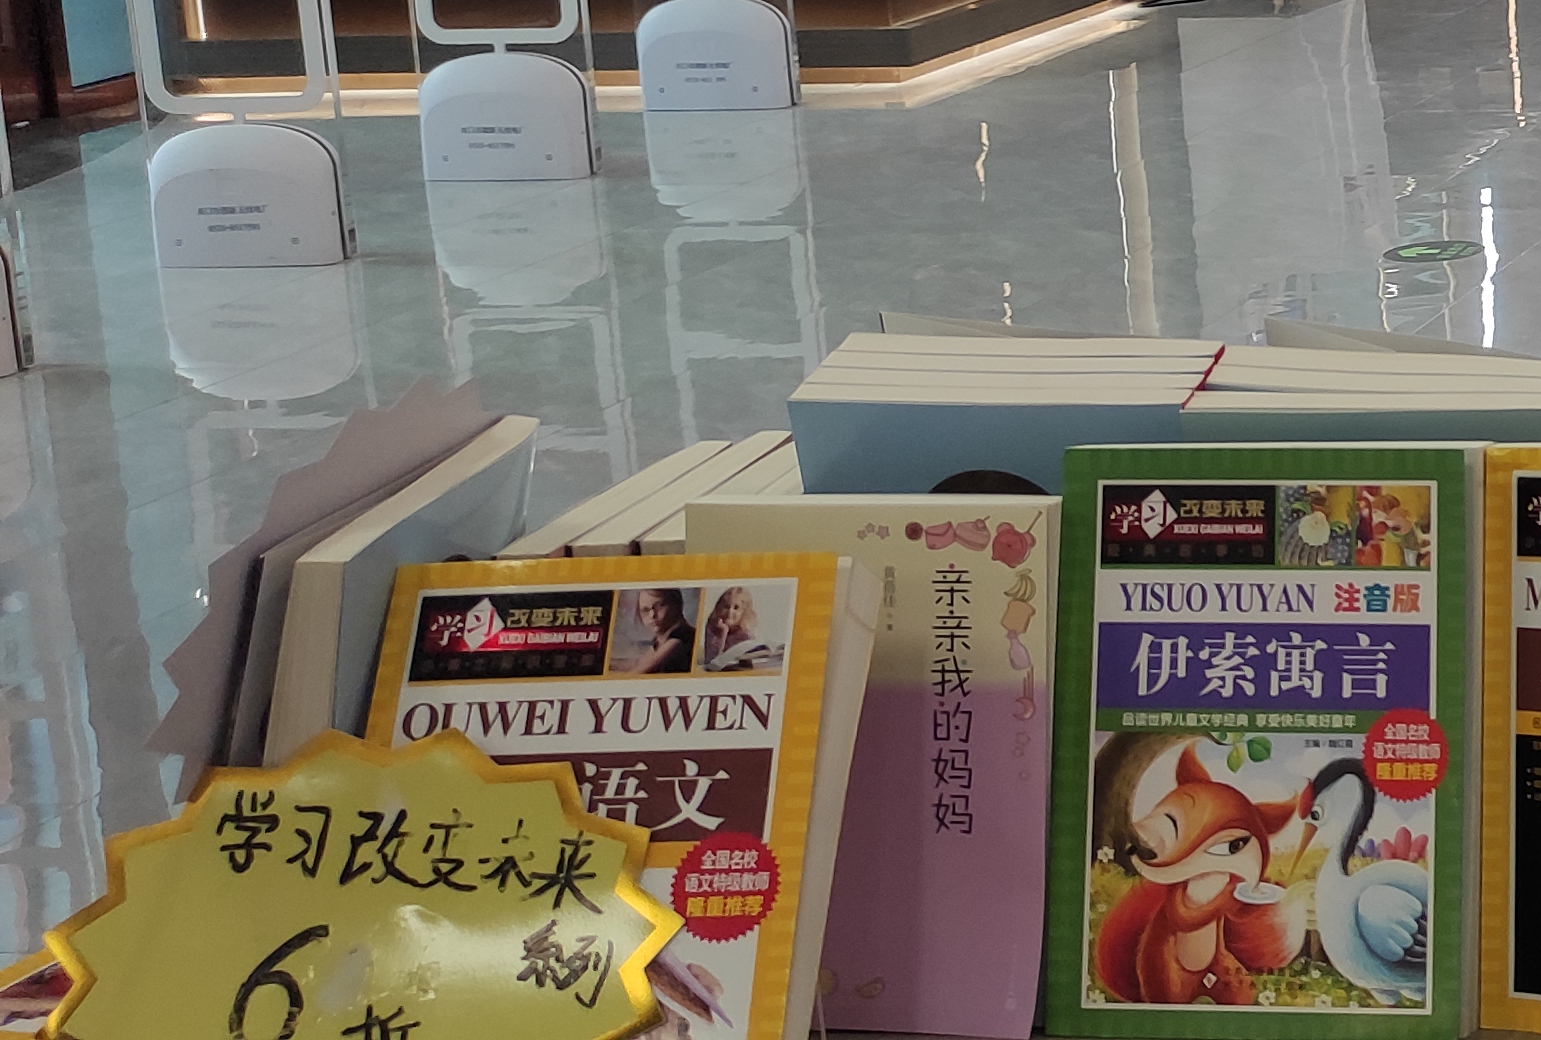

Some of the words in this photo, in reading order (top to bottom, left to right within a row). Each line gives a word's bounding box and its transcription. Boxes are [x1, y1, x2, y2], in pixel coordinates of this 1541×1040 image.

[1110, 498, 1174, 535] 学习
[1179, 499, 1265, 518] 改变未来
[1119, 583, 1209, 613] YISUO
[1215, 583, 1317, 613] YUYAN
[1334, 583, 1421, 614] 注音版
[429, 602, 503, 650] 学习
[506, 606, 604, 627] 改变未来
[1130, 631, 1396, 699] 伊索寓言
[585, 693, 776, 736] YUWEN
[930, 562, 974, 835] 亲亲我的妈妈
[214, 790, 604, 914] 学习改变未来
[700, 849, 758, 872] 全国名校
[685, 872, 771, 895] 语文特级教师
[685, 894, 764, 920] 隆重推荐
[516, 920, 614, 1008] 系列
